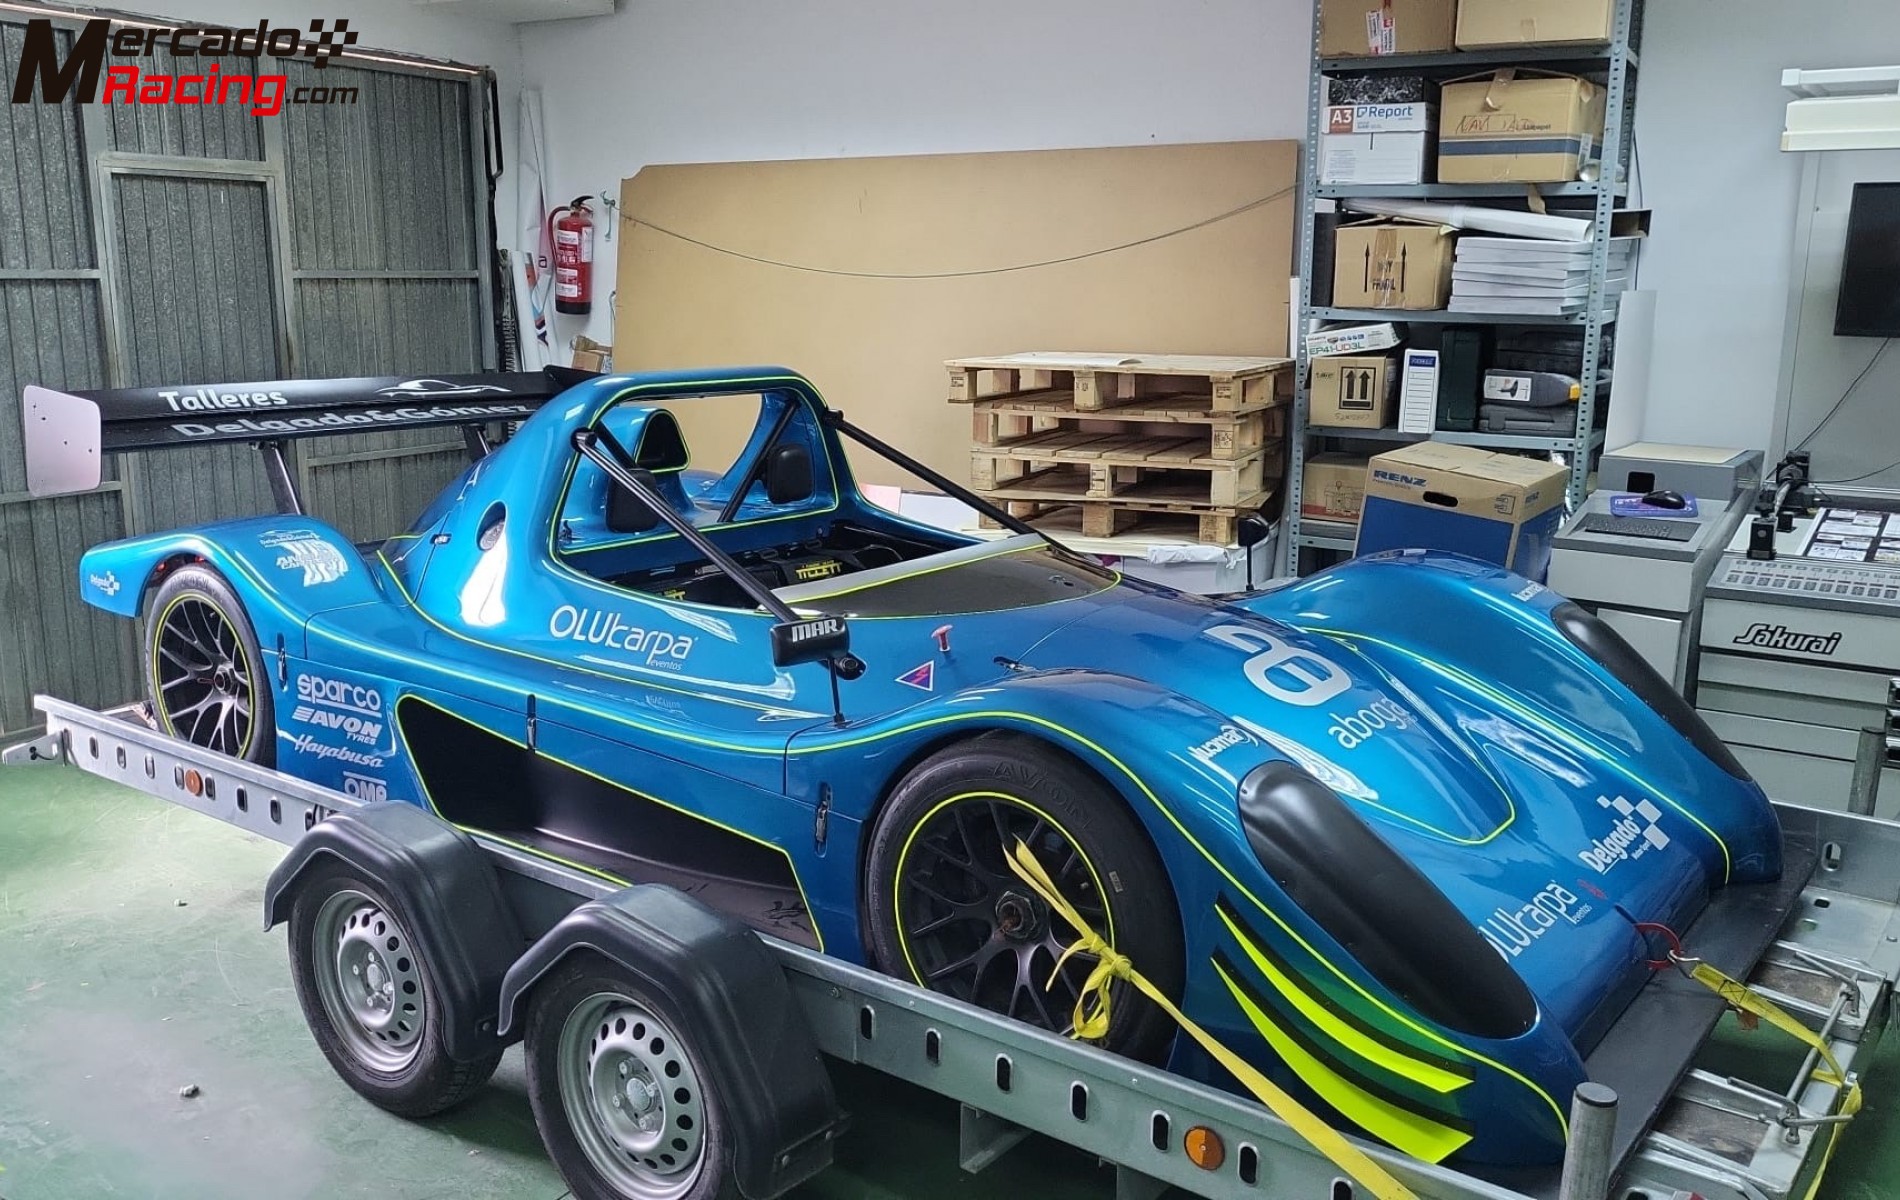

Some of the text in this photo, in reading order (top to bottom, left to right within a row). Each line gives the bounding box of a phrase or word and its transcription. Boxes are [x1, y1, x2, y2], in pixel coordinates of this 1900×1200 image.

[1332, 110, 1352, 124] A3
[1369, 106, 1413, 119] Report
[158, 391, 288, 412] Talleres
[1373, 470, 1427, 487] RENZ
[791, 619, 838, 643] MAR
[1732, 622, 1843, 655] Sakurai
[651, 659, 683, 671] eventos
[297, 673, 381, 711] sparco
[310, 710, 382, 738] AVON
[346, 732, 377, 745] TYRES
[295, 734, 384, 768] Hayabusa
[344, 778, 387, 800] OMP
[993, 760, 1094, 830] AVON
[1578, 819, 1641, 873] Delgado
